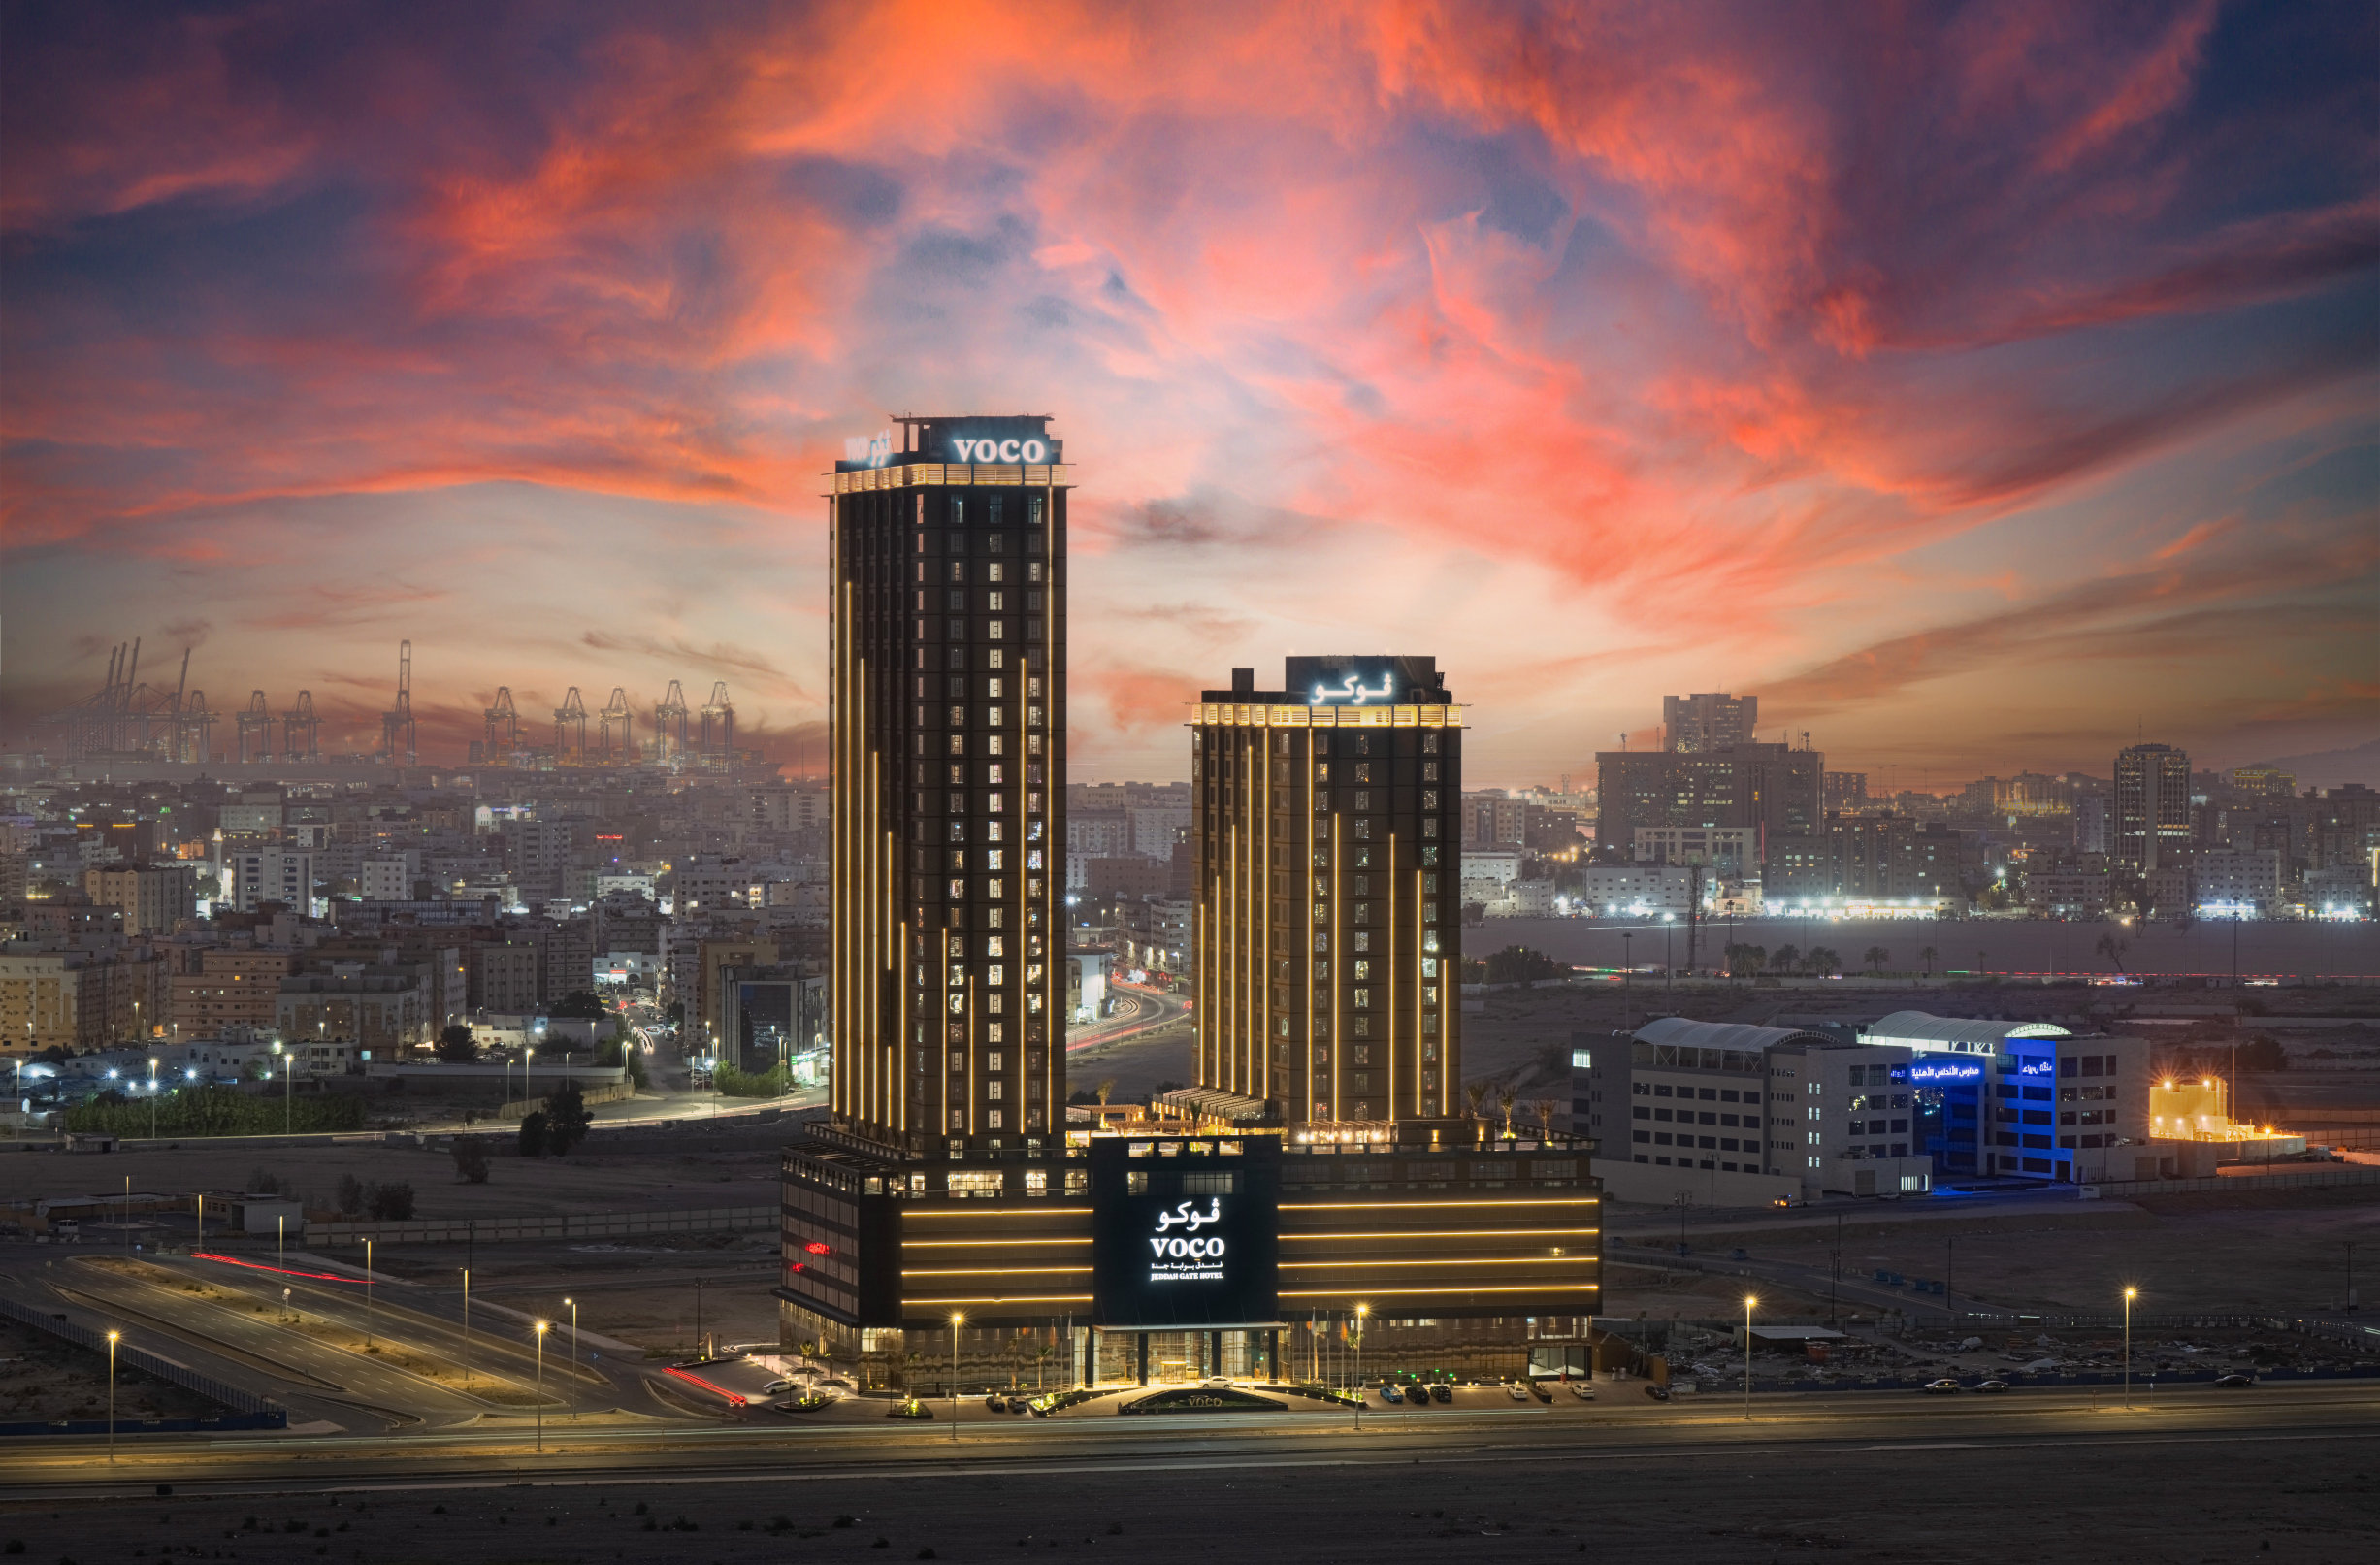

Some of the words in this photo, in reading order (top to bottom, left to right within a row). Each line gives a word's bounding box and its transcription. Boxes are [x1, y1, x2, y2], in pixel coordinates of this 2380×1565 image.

[954, 439, 1045, 463] VOCO
[1911, 1066, 1934, 1079] الأهلية
[1935, 1065, 1958, 1078] الأندلس
[1959, 1067, 1979, 1077] مدارس
[1150, 1237, 1225, 1258] VOCO
[1151, 1272, 1178, 1282] JEDDAH
[1199, 1271, 1224, 1280] HOTEL
[1189, 1397, 1223, 1407] VOCO
